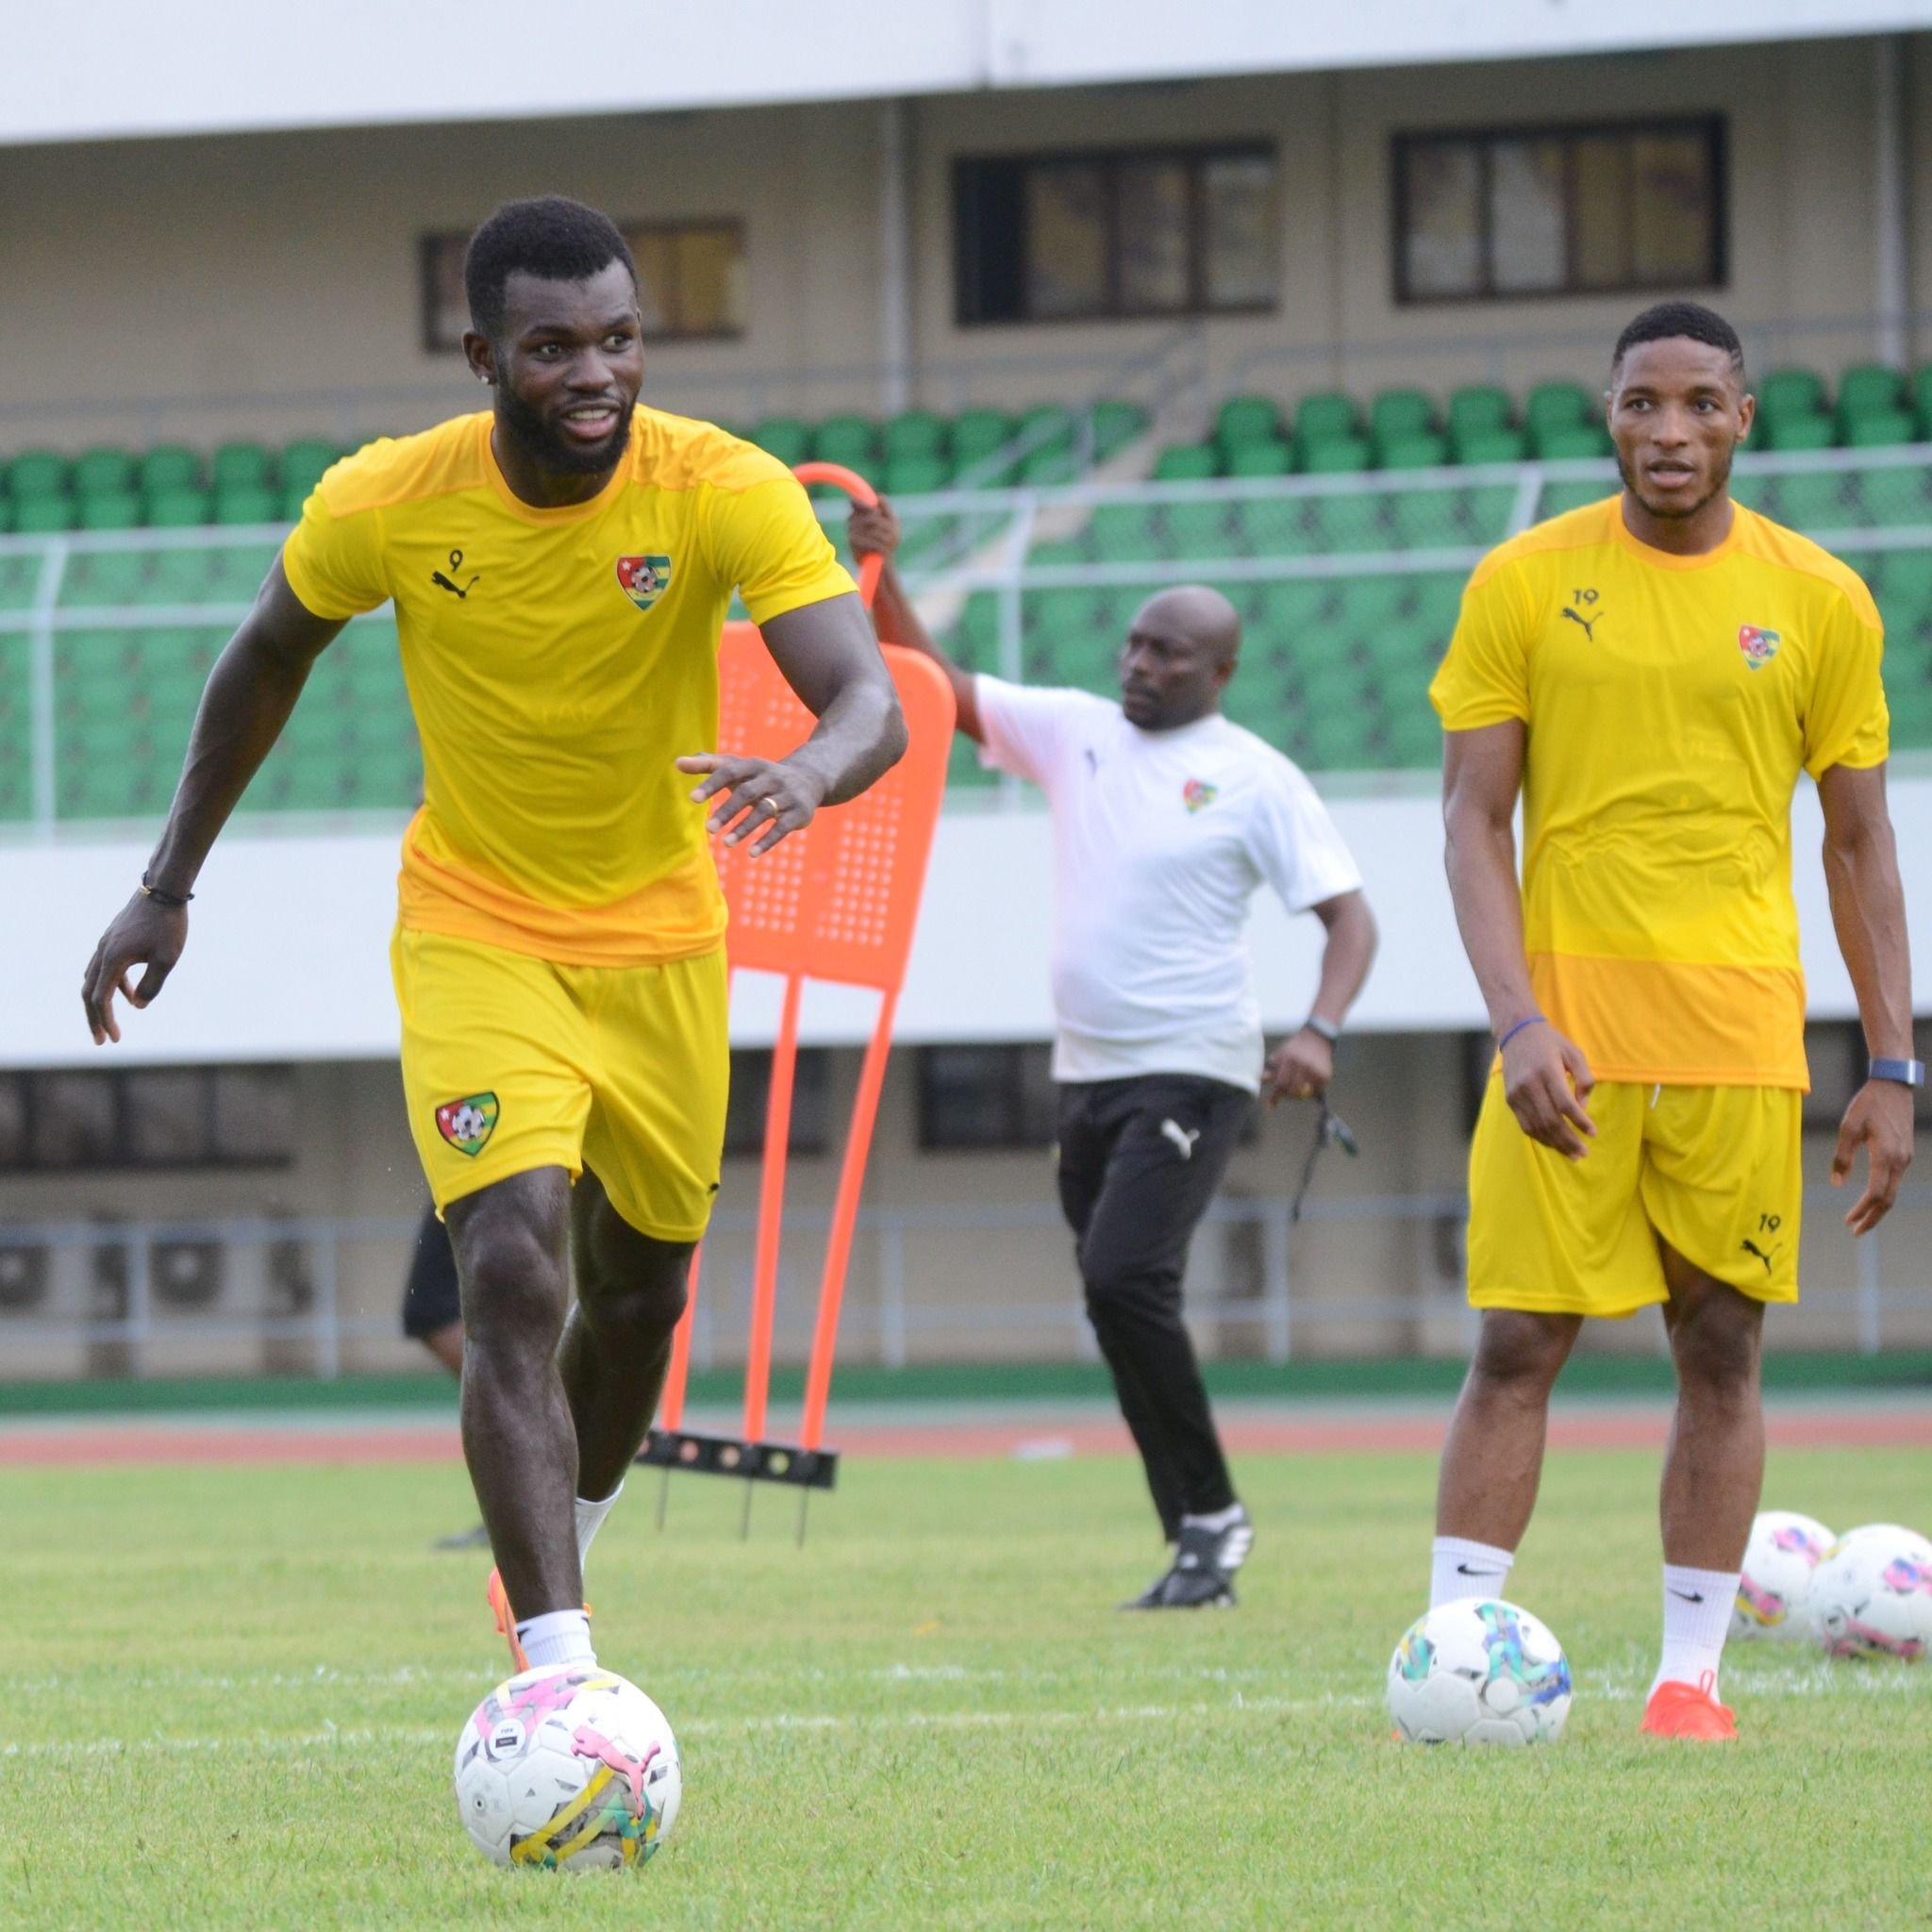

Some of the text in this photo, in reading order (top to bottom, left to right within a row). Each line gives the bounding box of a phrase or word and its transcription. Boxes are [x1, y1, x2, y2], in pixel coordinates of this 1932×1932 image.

[449, 549, 463, 573] 9
[1574, 588, 1599, 605] 19
[1759, 1213, 1781, 1232] 19
